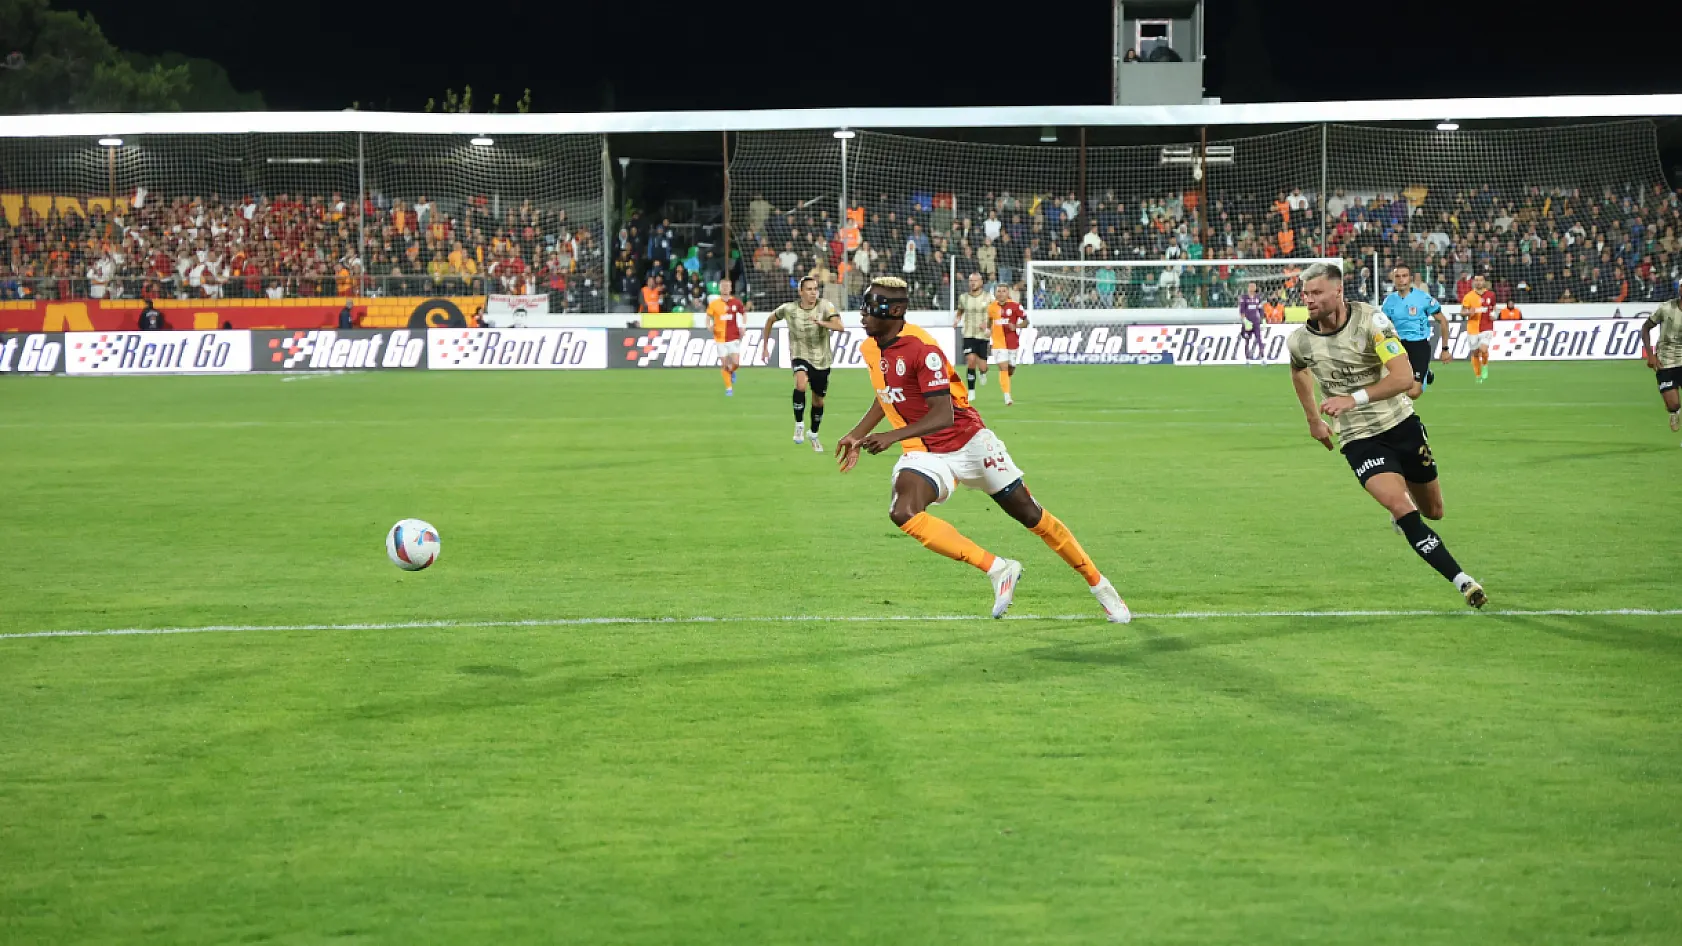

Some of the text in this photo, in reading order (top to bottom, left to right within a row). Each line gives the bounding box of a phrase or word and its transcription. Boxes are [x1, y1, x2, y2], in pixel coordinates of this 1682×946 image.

[18, 333, 62, 371] Go
[117, 333, 231, 368] Rent Go
[308, 328, 424, 368] Rent Go
[478, 330, 588, 365] Rent Go
[662, 329, 776, 367] Ren Go
[830, 330, 864, 364] Re
[1085, 327, 1123, 353] Go
[1177, 326, 1241, 362] Rent
[1531, 320, 1643, 357] Rent Go
